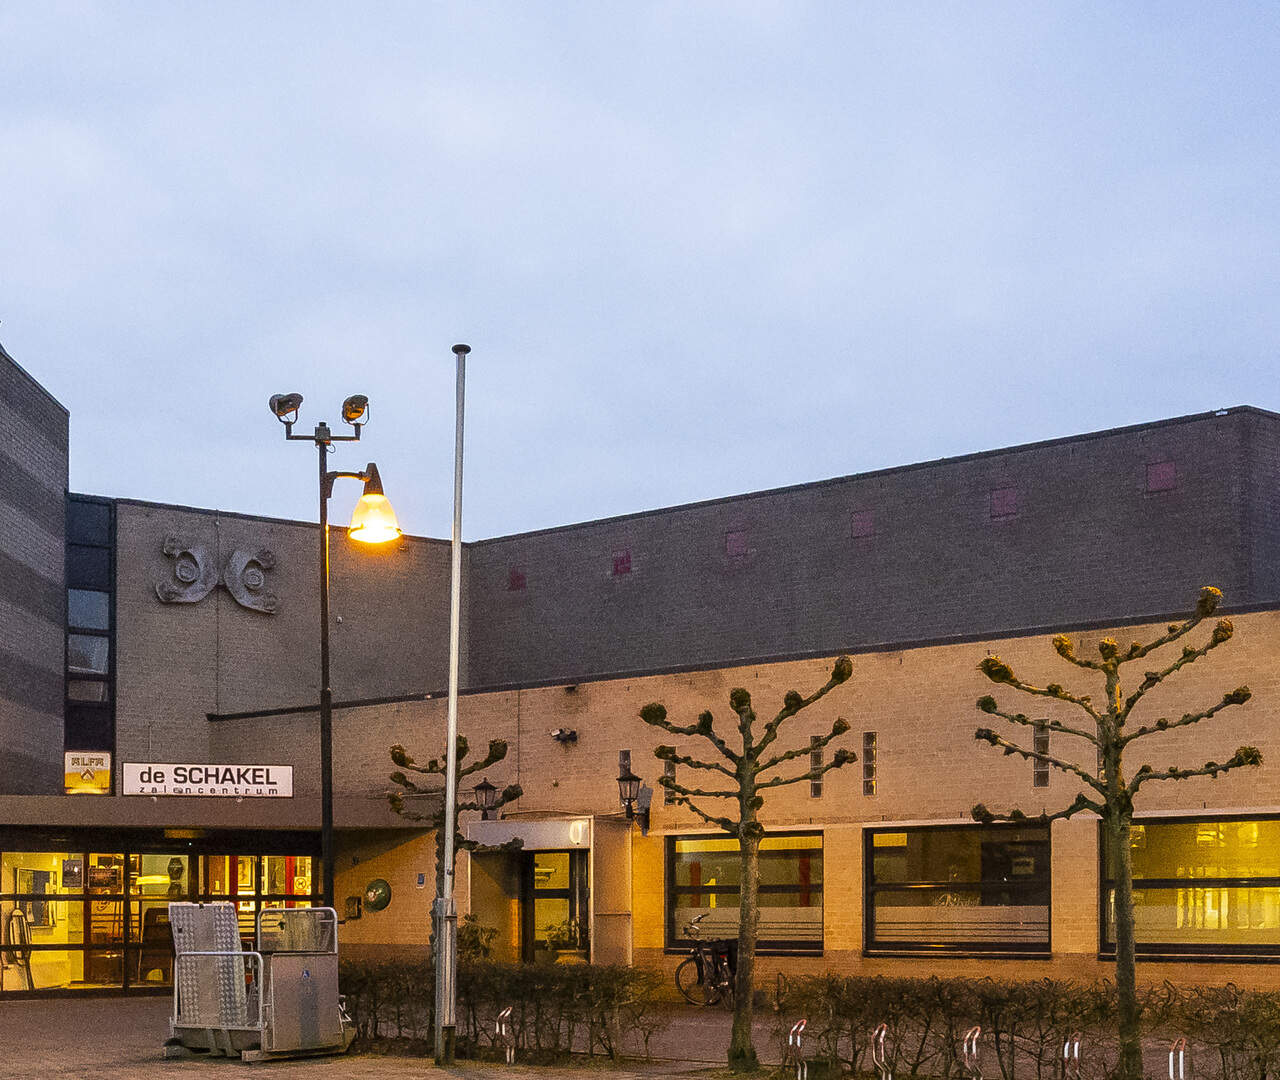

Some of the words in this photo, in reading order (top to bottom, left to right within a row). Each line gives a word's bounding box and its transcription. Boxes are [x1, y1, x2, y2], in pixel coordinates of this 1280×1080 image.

[71, 757, 104, 766] ALFA
[139, 767, 165, 783] de
[173, 767, 277, 785] SCHAKEL
[139, 786, 278, 795] zalencentrum
